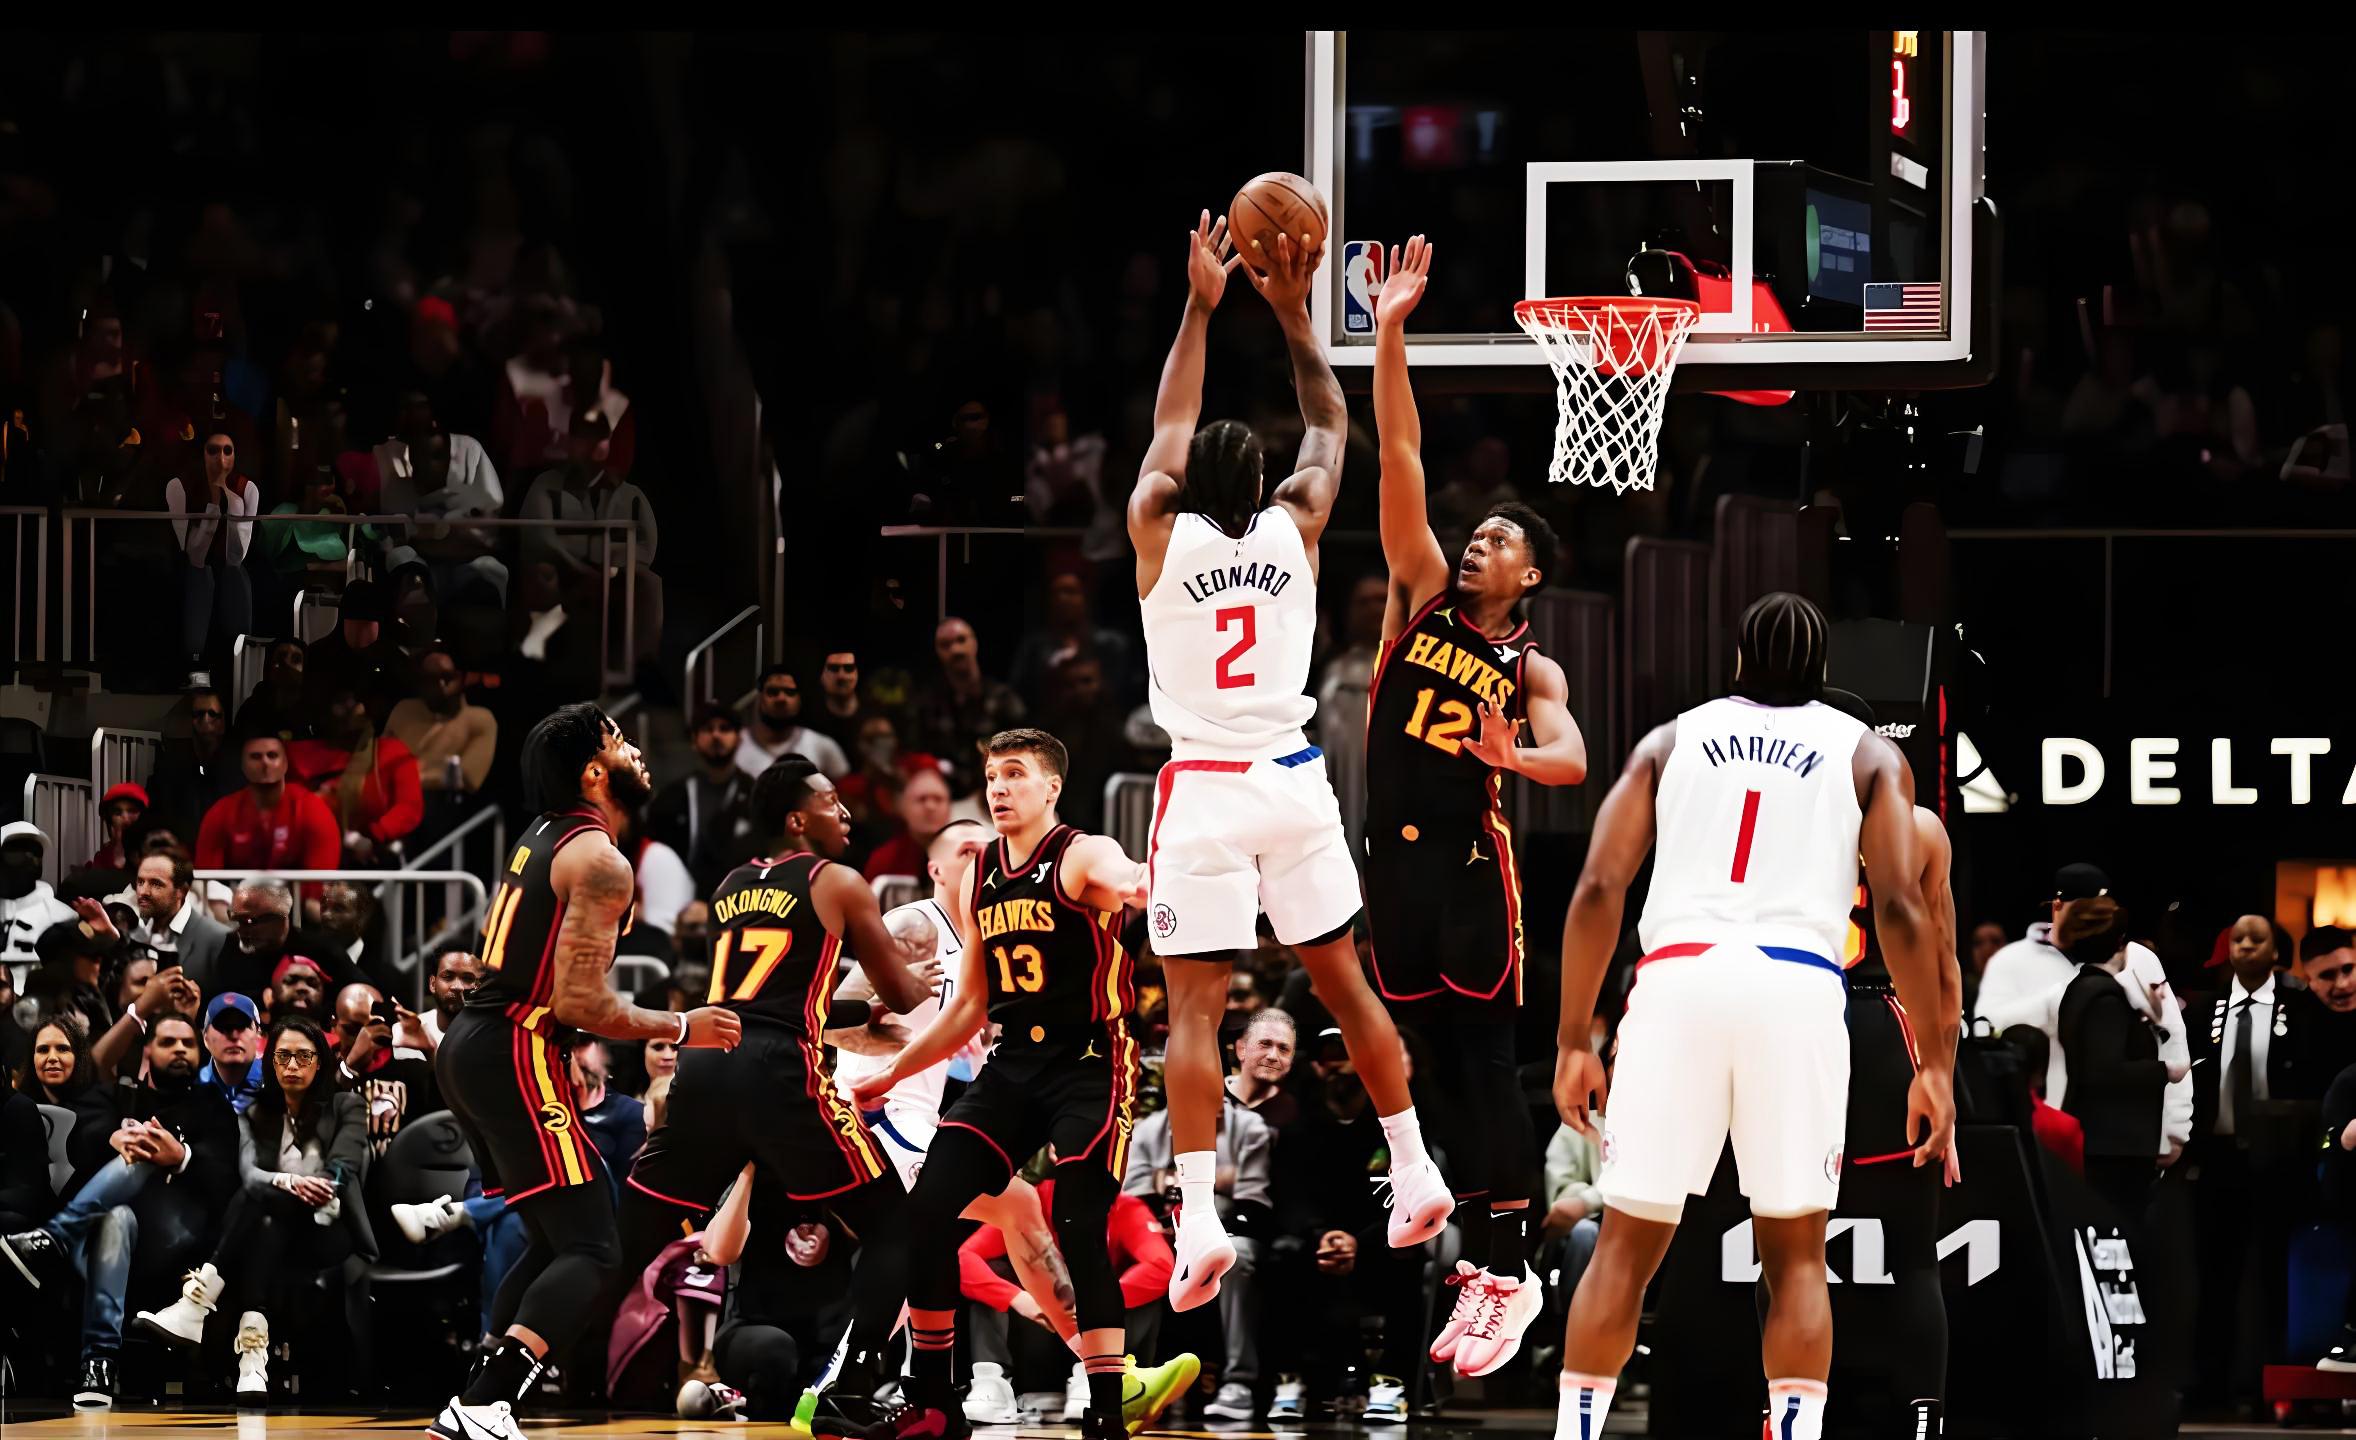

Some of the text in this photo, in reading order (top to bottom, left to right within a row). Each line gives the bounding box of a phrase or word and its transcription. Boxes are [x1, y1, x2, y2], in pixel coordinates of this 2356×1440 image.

[1183, 562, 1292, 603] LEONARD
[1216, 605, 1256, 689] 2
[1404, 632, 1516, 710] HAWKS
[1404, 687, 1474, 757] 12
[1702, 735, 1824, 778] HARDEN
[2042, 738, 2356, 805] DELT
[1730, 788, 1761, 883] 1
[714, 888, 798, 924] OKONGWU
[977, 898, 1056, 942] HAWKS
[706, 927, 793, 1005] 17
[993, 944, 1044, 993] 13
